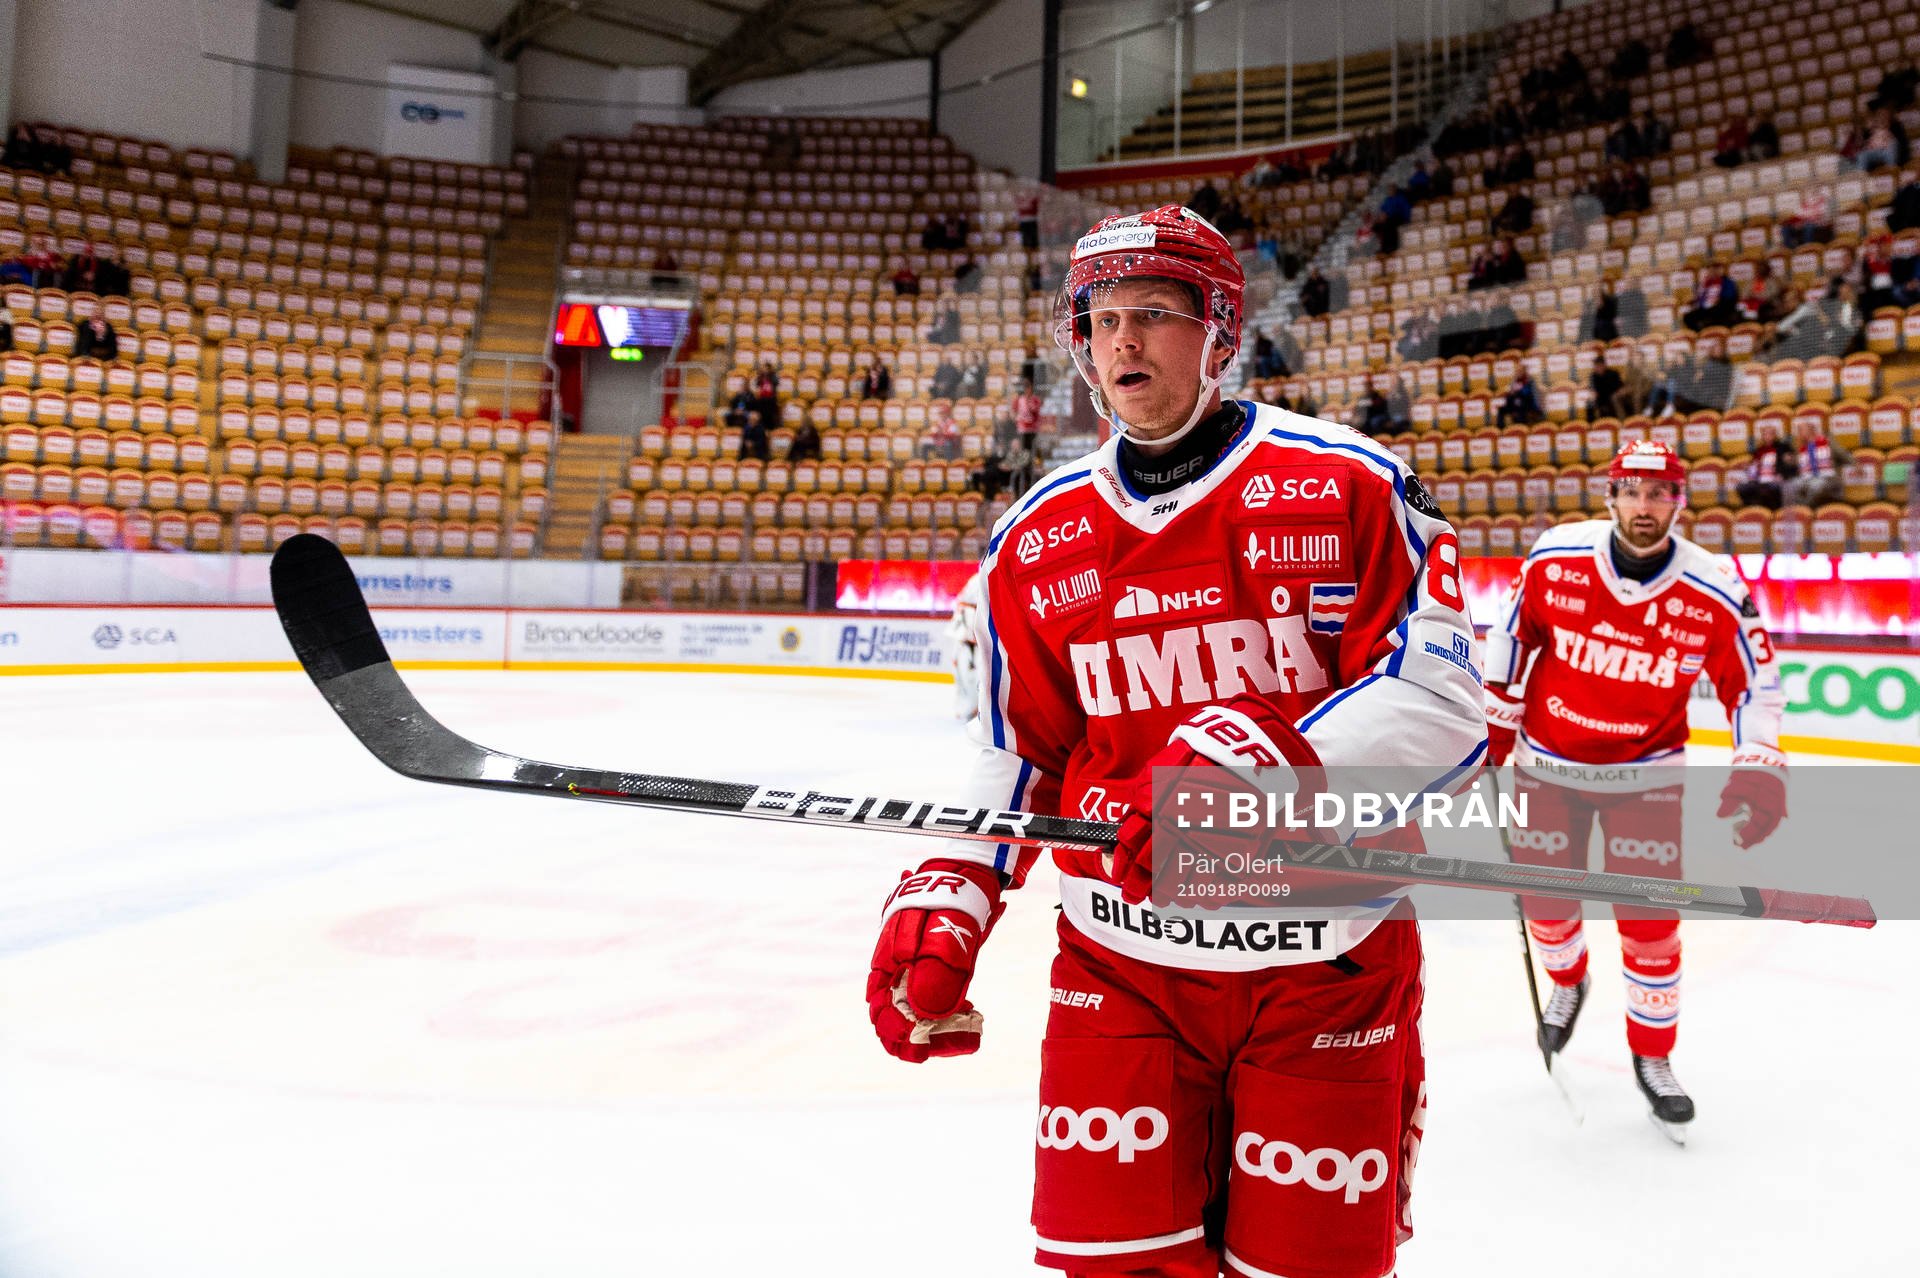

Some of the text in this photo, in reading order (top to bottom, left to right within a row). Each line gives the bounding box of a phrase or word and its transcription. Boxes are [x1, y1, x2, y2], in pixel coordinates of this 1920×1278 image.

[1281, 478, 1341, 500] SCA
[1048, 516, 1093, 548] SCA
[1270, 535, 1340, 562] LILIUM
[1048, 568, 1102, 607] LILIUM
[1563, 569, 1590, 587] SCA
[1163, 587, 1222, 612] NHC
[1684, 605, 1713, 624] SCA
[1553, 625, 1678, 688] TIMRÅ
[1778, 662, 1920, 720] coo
[1559, 706, 1649, 736] consembly
[1535, 757, 1640, 782] BILBOLAGET
[1609, 836, 1678, 866] coop
[1091, 891, 1328, 953] BILBOLAGET
[1036, 1105, 1169, 1163] coop
[1235, 1131, 1389, 1204] coop
